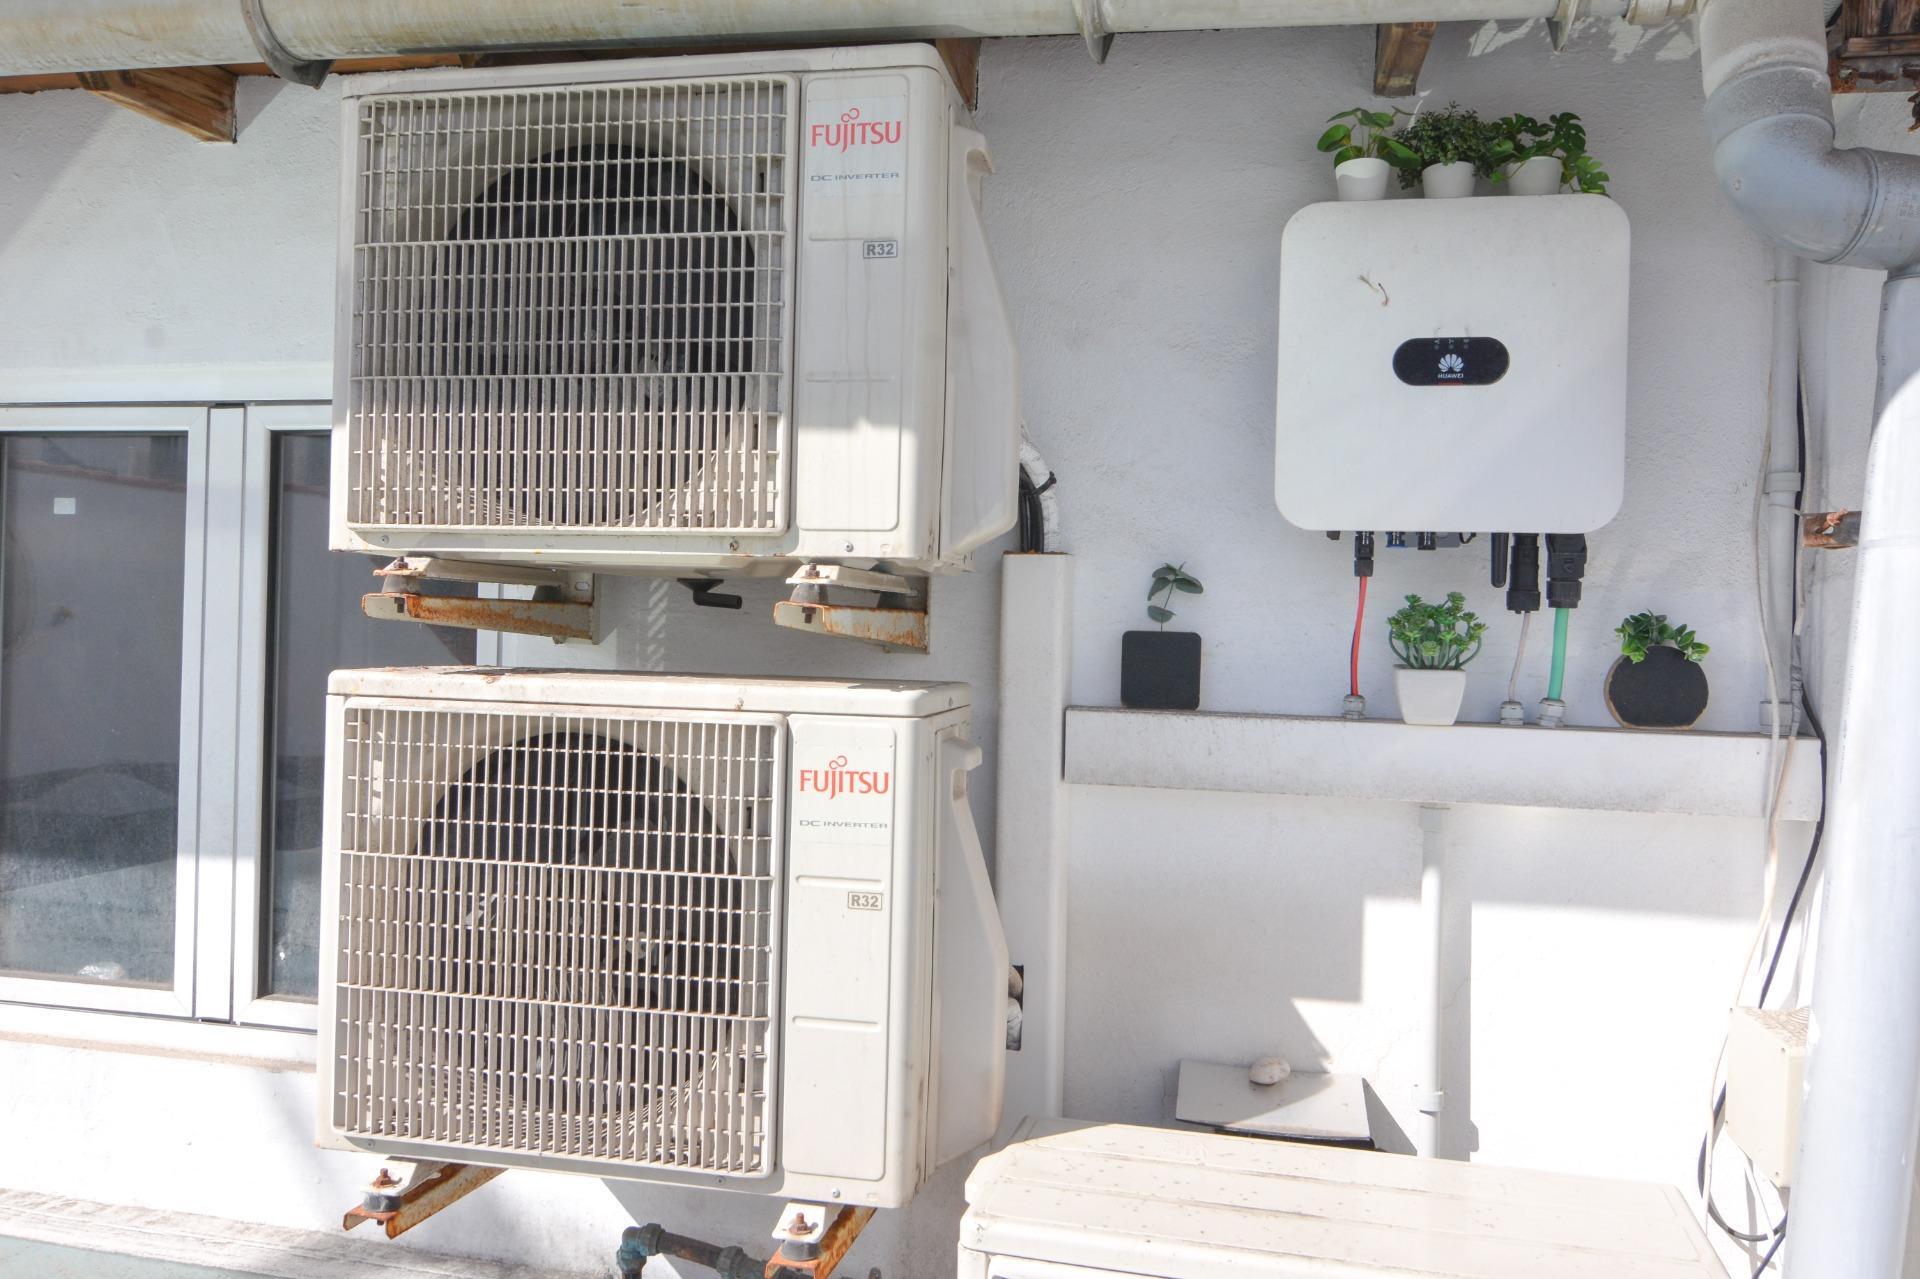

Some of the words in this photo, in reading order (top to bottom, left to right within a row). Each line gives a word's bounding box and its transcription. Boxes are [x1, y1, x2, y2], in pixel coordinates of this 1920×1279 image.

[811, 111, 902, 153] FUJITSU
[810, 174, 832, 182] DC
[835, 172, 900, 181] INVERTER
[866, 243, 895, 256] R32
[799, 758, 890, 800] FUJITSU
[799, 819, 821, 827] DC
[824, 821, 888, 829] INVERTER
[851, 895, 879, 908] R32
